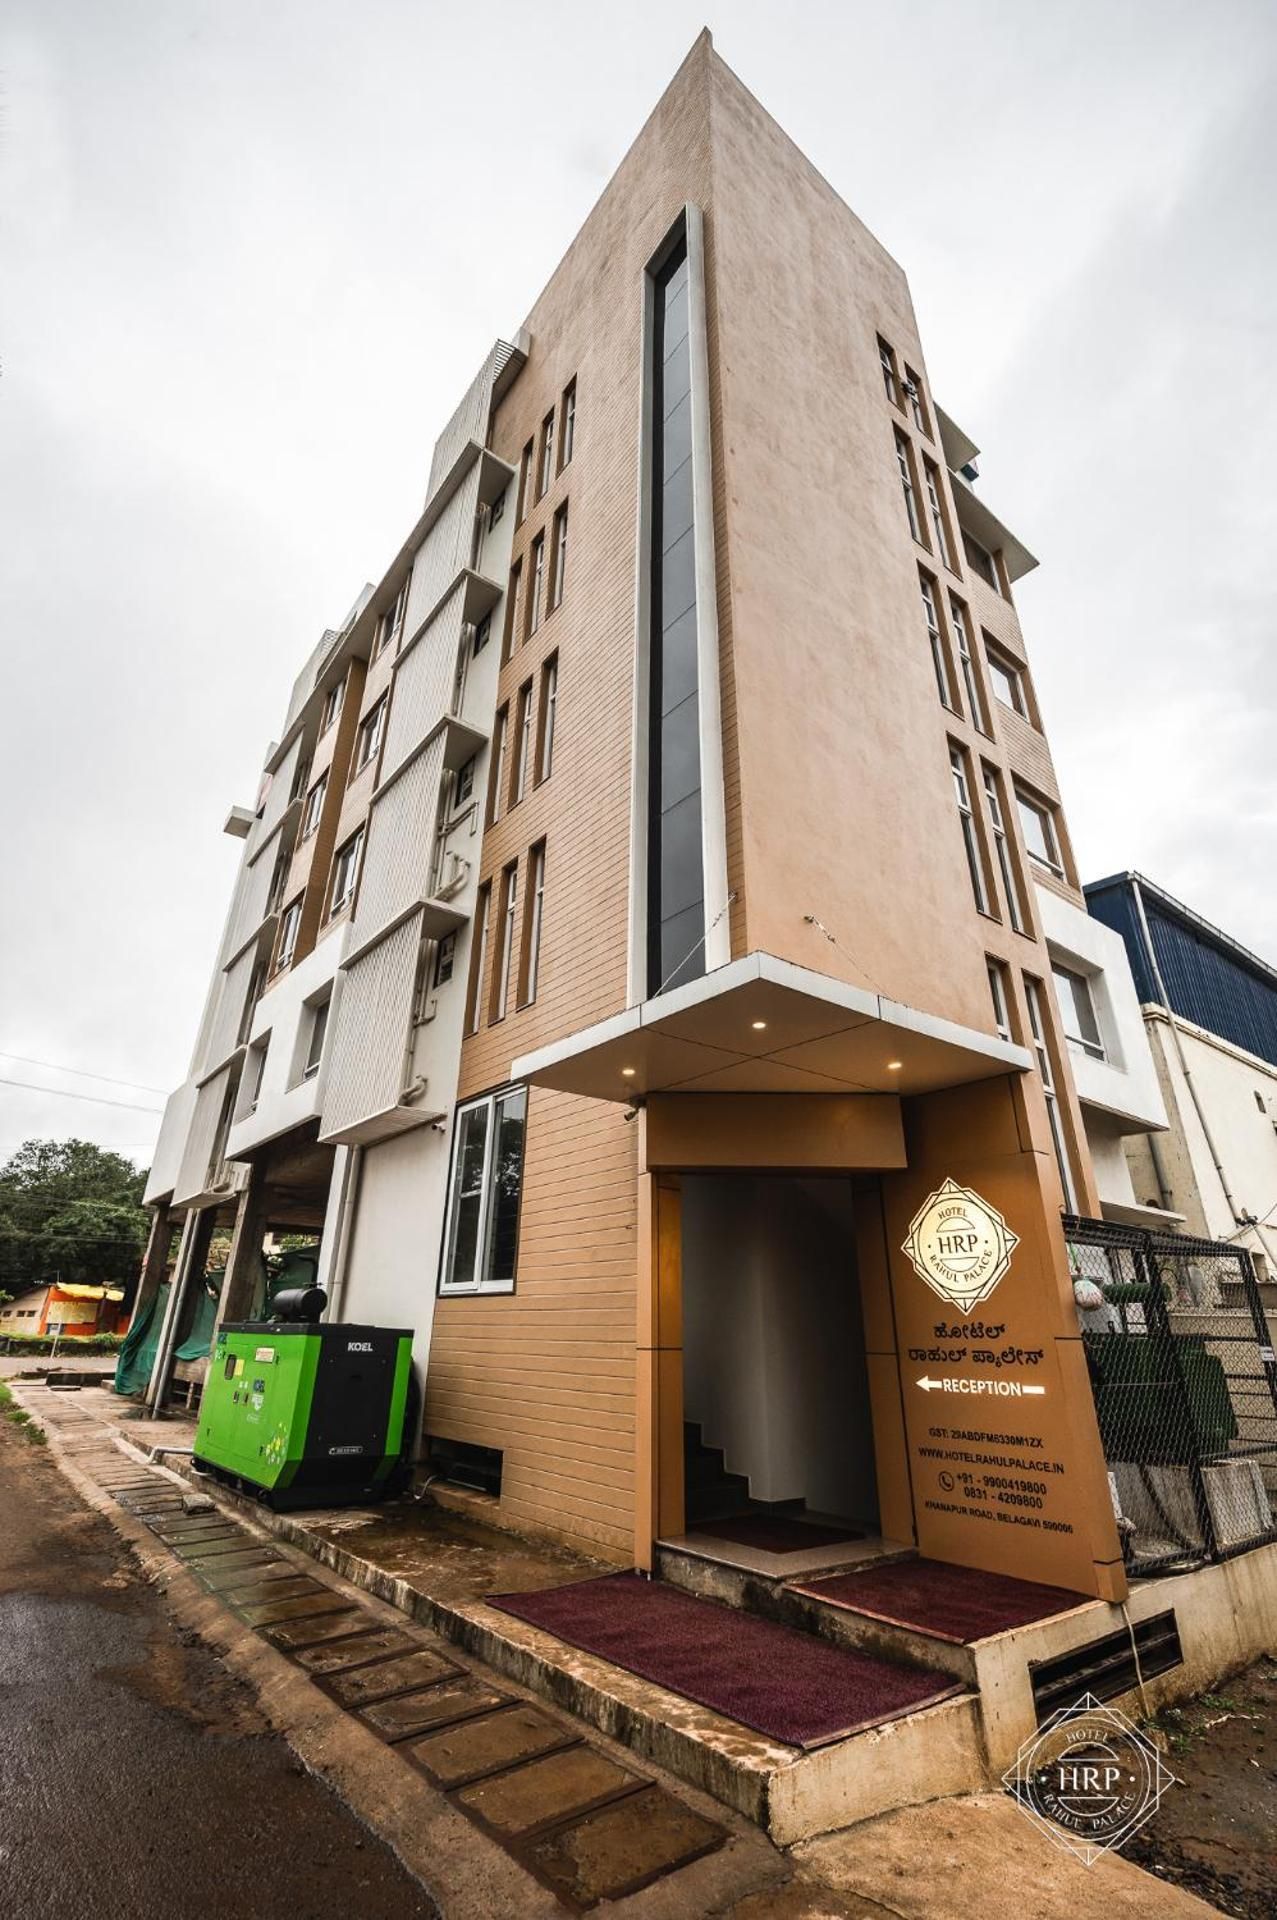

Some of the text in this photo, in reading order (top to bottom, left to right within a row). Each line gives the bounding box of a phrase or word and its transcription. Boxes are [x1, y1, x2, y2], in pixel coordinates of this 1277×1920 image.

[938, 1207, 968, 1219] HOTEL
[937, 1234, 978, 1254] HRP
[930, 1249, 993, 1283] RAHUL PALACE
[934, 1322, 1005, 1339] ಹೋಟೆಲ್
[347, 1342, 373, 1352] KOEL
[908, 1346, 967, 1362] ರಾಹುಲ್
[943, 1378, 1022, 1396] RECEPTION
[929, 1427, 949, 1438] GST:
[918, 1447, 1064, 1474] WWW.HOTELRAHULPALACE.IN
[956, 1472, 973, 1485] +91
[983, 1475, 1047, 1495] 9900419800
[964, 1486, 987, 1500] 0831
[998, 1492, 1043, 1509] 4209800
[925, 1500, 967, 1516] KHANAPUR
[969, 1507, 996, 1521] ROAD,
[997, 1512, 1041, 1529] BELAGAVI
